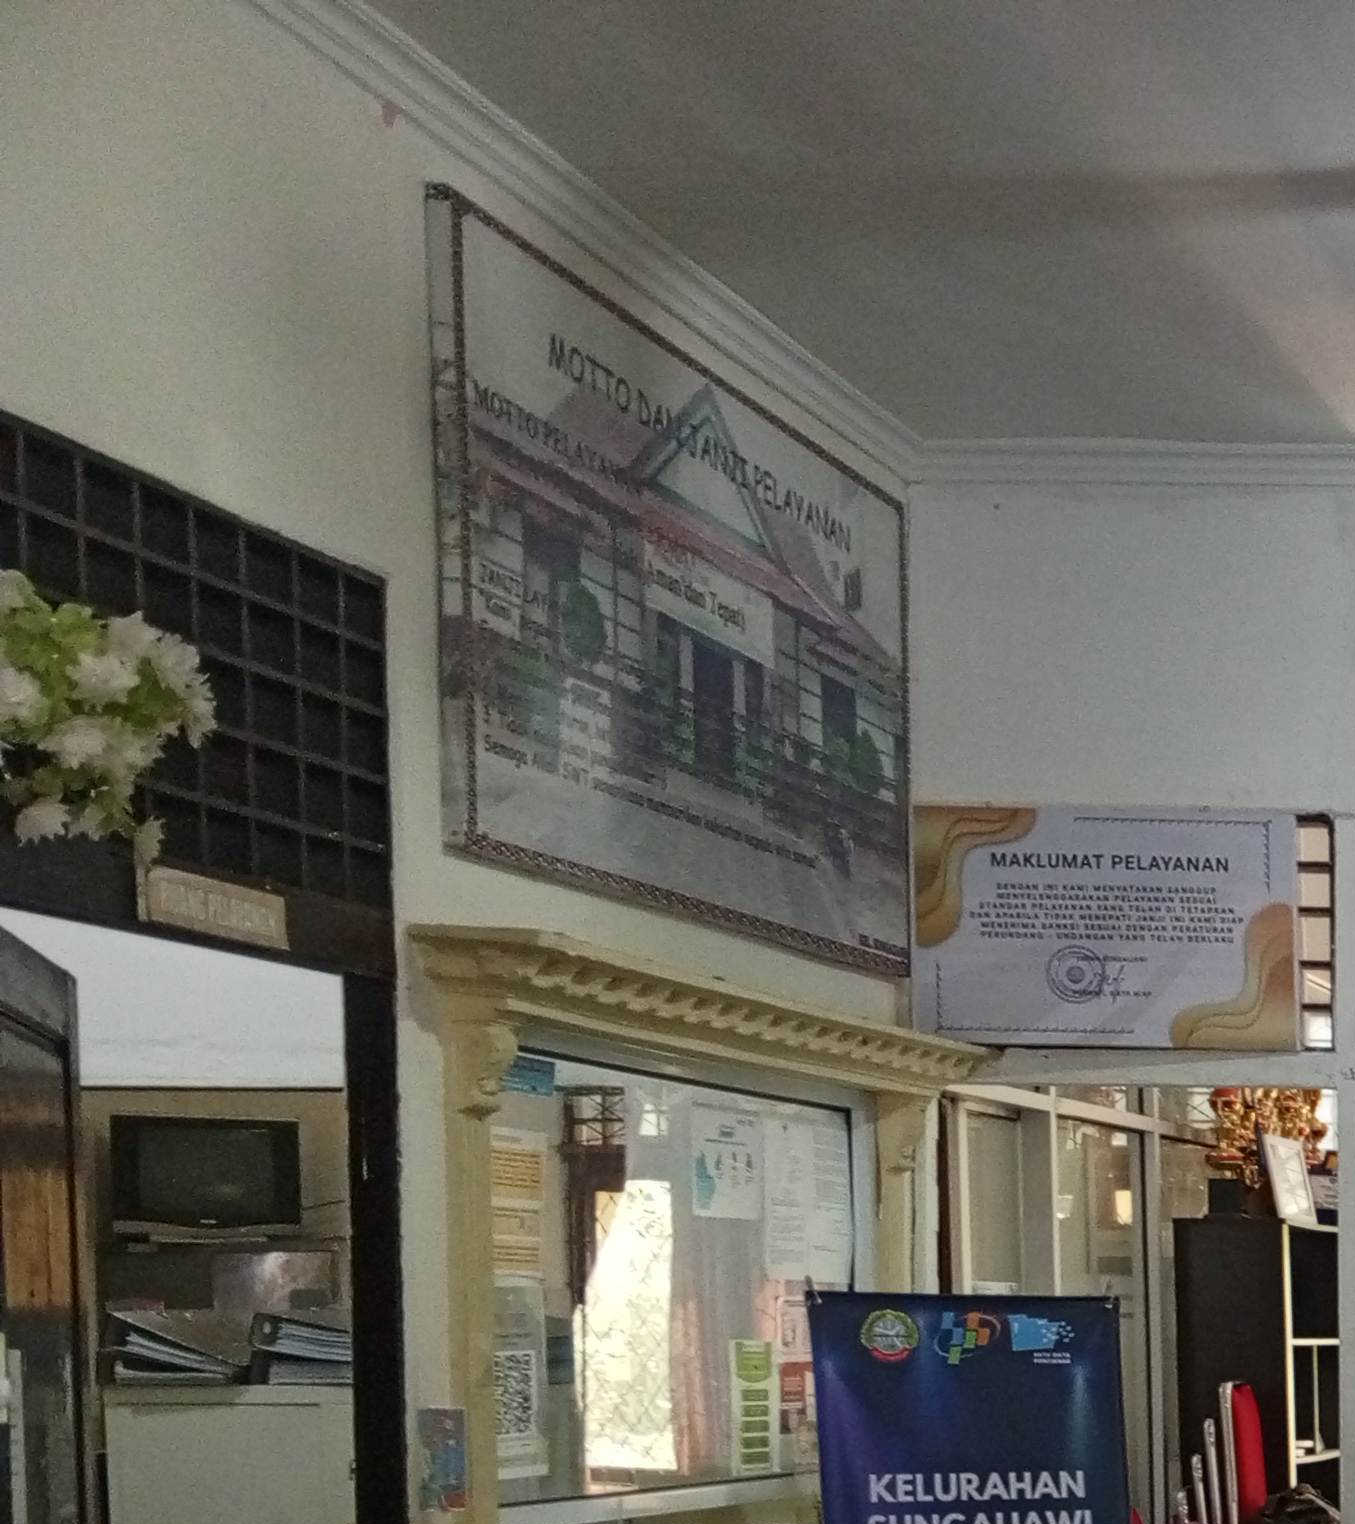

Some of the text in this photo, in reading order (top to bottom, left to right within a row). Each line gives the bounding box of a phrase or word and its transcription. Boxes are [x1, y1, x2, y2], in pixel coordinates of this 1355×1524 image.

[548, 332, 632, 415] MOTTO
[753, 462, 851, 554] PELAYANAN
[990, 852, 1230, 873] MAKLUMAT PELAYANAN
[867, 1470, 1086, 1503] KELURAHAN
